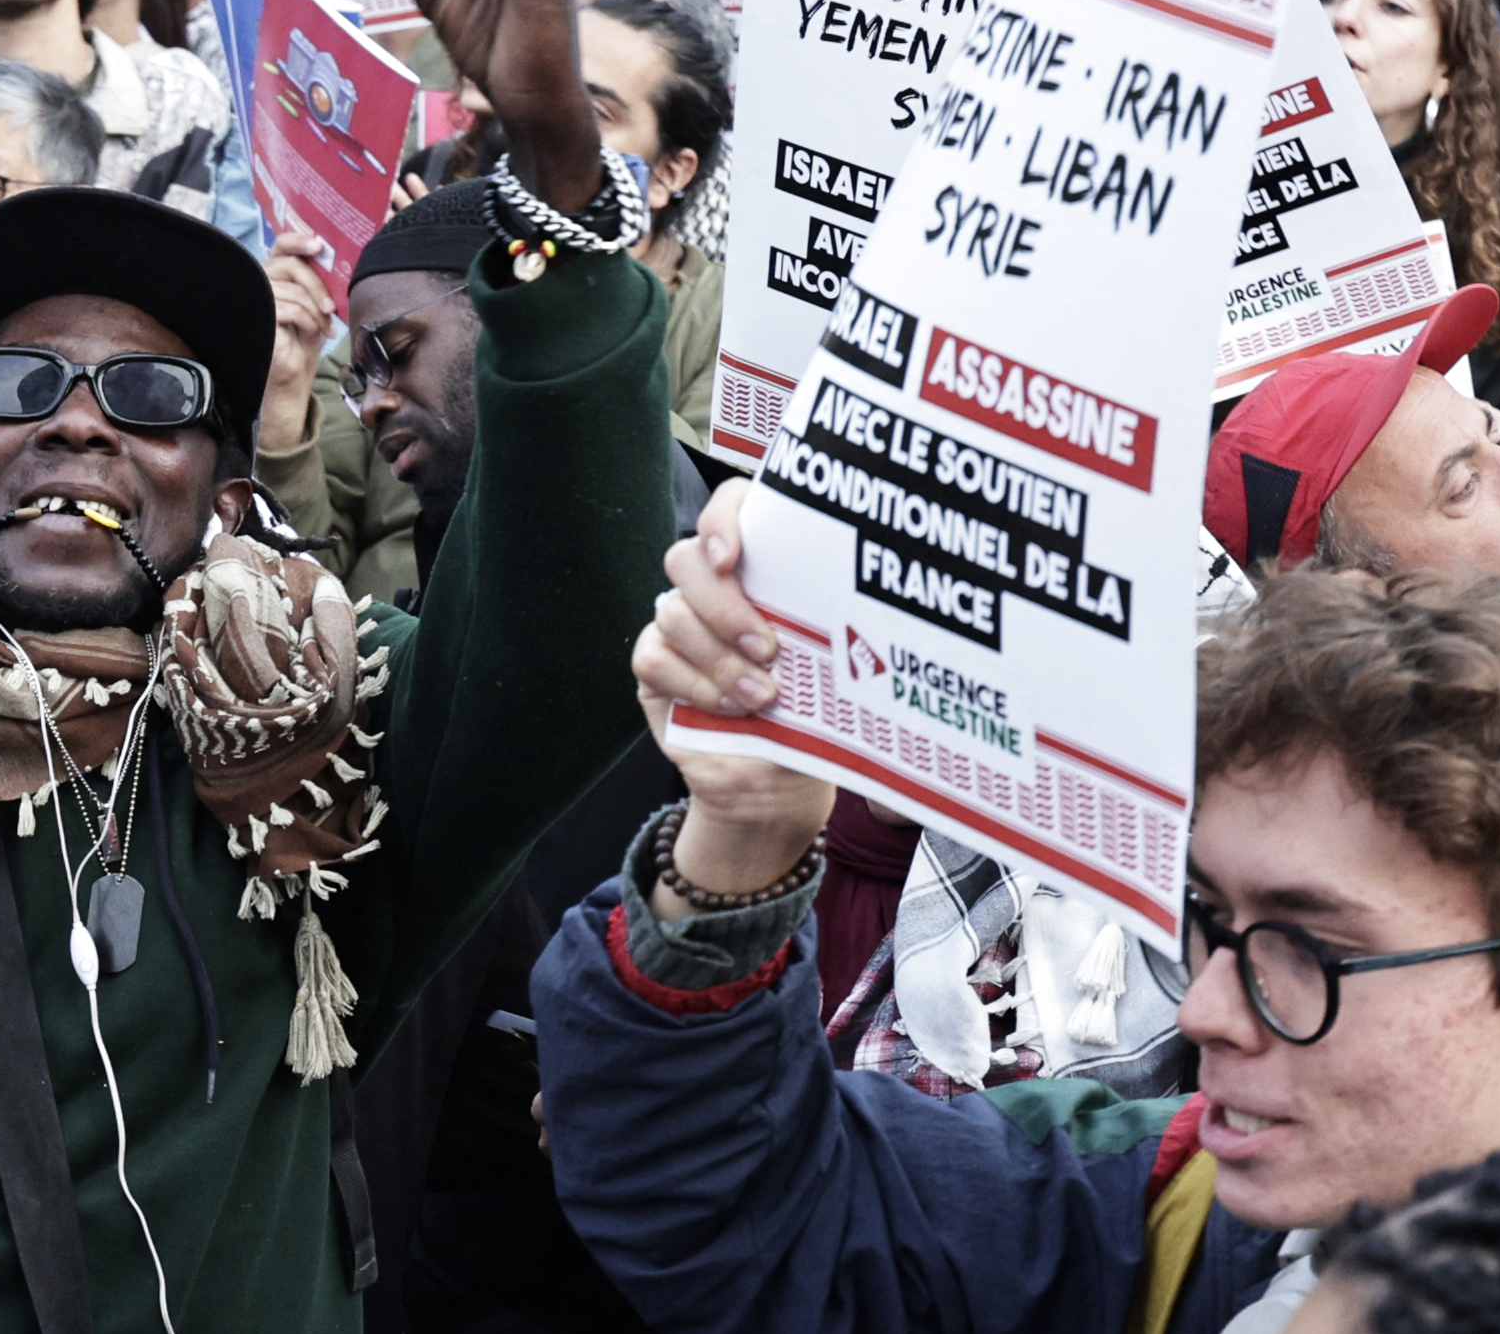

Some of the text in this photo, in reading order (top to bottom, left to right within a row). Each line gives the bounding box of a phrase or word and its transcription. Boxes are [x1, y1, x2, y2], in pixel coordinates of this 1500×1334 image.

[1104, 57, 1228, 158] IRAN
[1019, 121, 1176, 237] LIBAN
[1279, 162, 1352, 204] DE LA
[924, 184, 1042, 279] SYRIE
[1225, 267, 1308, 308] URGENCE
[1228, 280, 1322, 326] PALESTINE
[927, 336, 1139, 466] ASSASSINE
[811, 384, 1081, 538] AVEC LE SOUTIEN
[767, 429, 1124, 625] INCONDITIONNEL DE LA
[860, 540, 995, 635] FRANCE
[888, 642, 1009, 717] URGENCE
[892, 671, 1024, 757] PALESTINE
